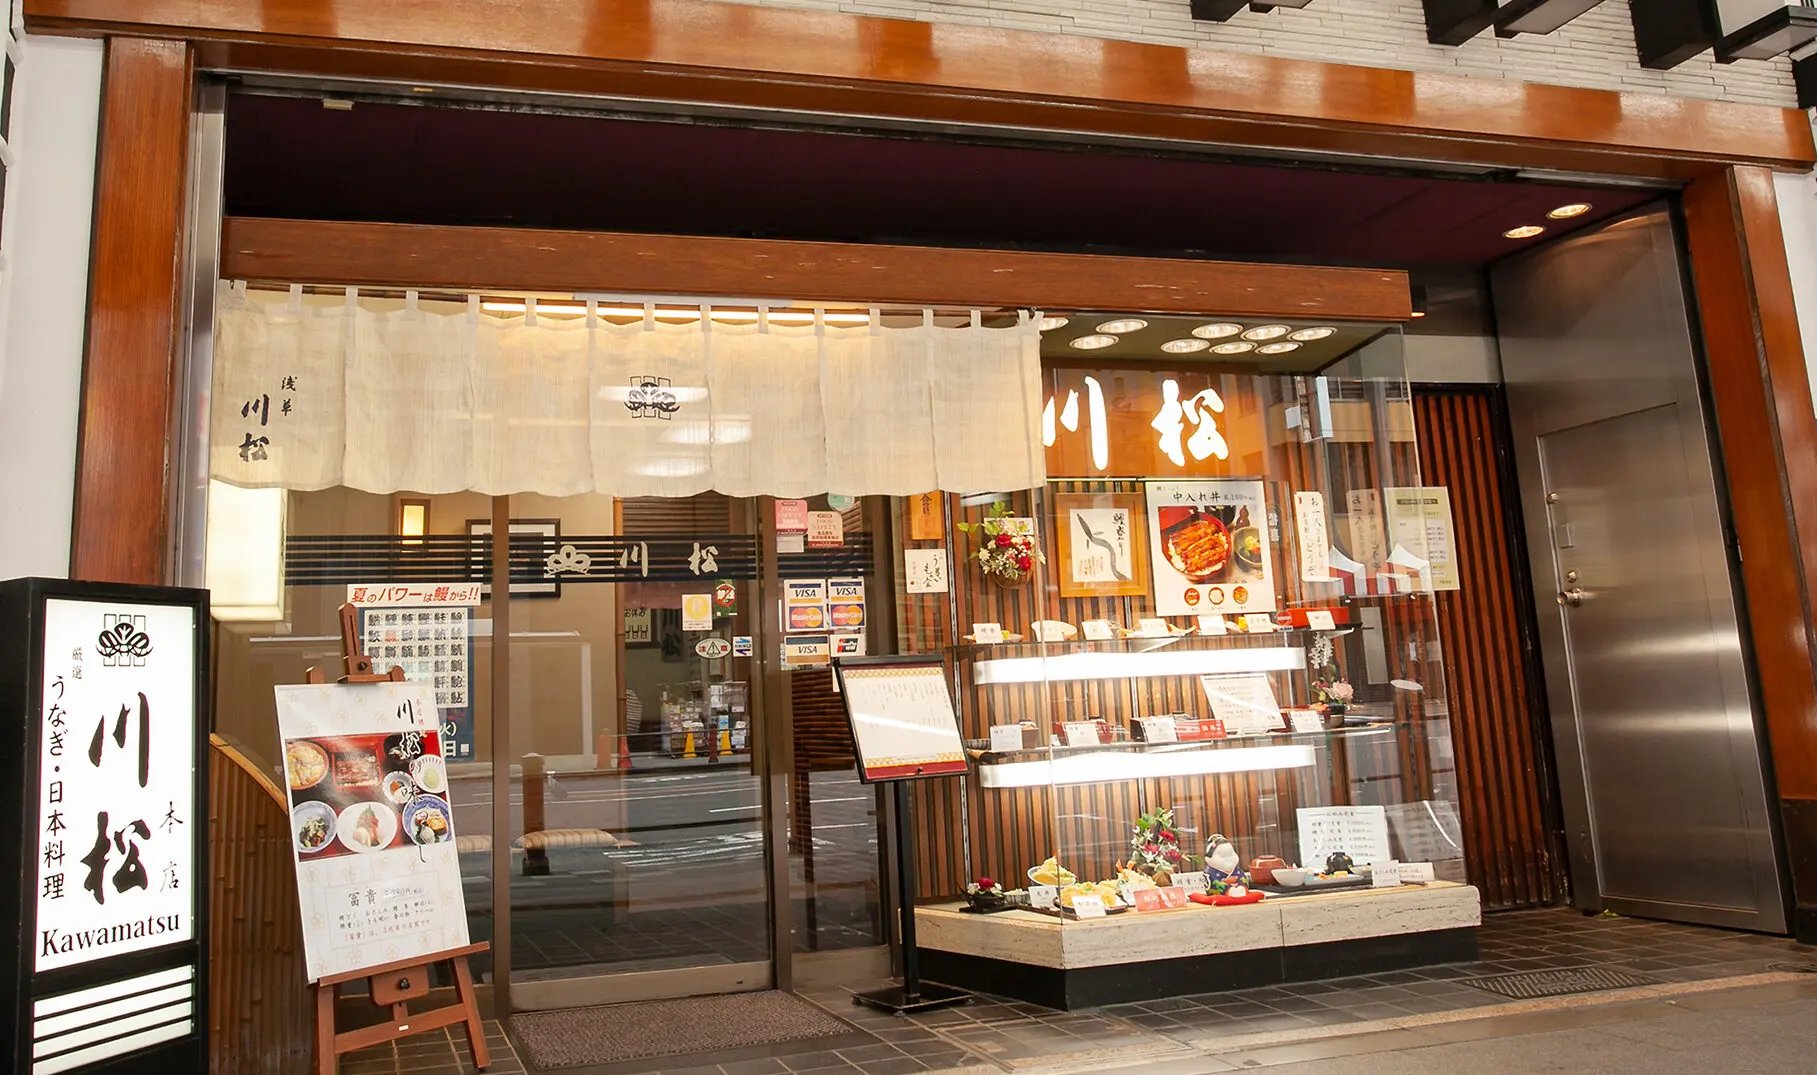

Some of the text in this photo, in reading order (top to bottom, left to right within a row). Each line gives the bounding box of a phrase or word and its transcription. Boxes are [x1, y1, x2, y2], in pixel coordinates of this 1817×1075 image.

[281, 376, 298, 416] 浅草
[239, 394, 270, 462] 川松
[1043, 376, 1229, 470] 川松
[620, 541, 719, 578] 川松
[351, 586, 479, 603] 夏のパワーは鰻から!!
[794, 589, 817, 598] VISA
[836, 587, 857, 596] VISA
[798, 646, 818, 655] VISA
[43, 675, 69, 900] うなぎ・日本料理
[80, 691, 151, 905] 川松
[41, 912, 181, 957] Kawamatsu
